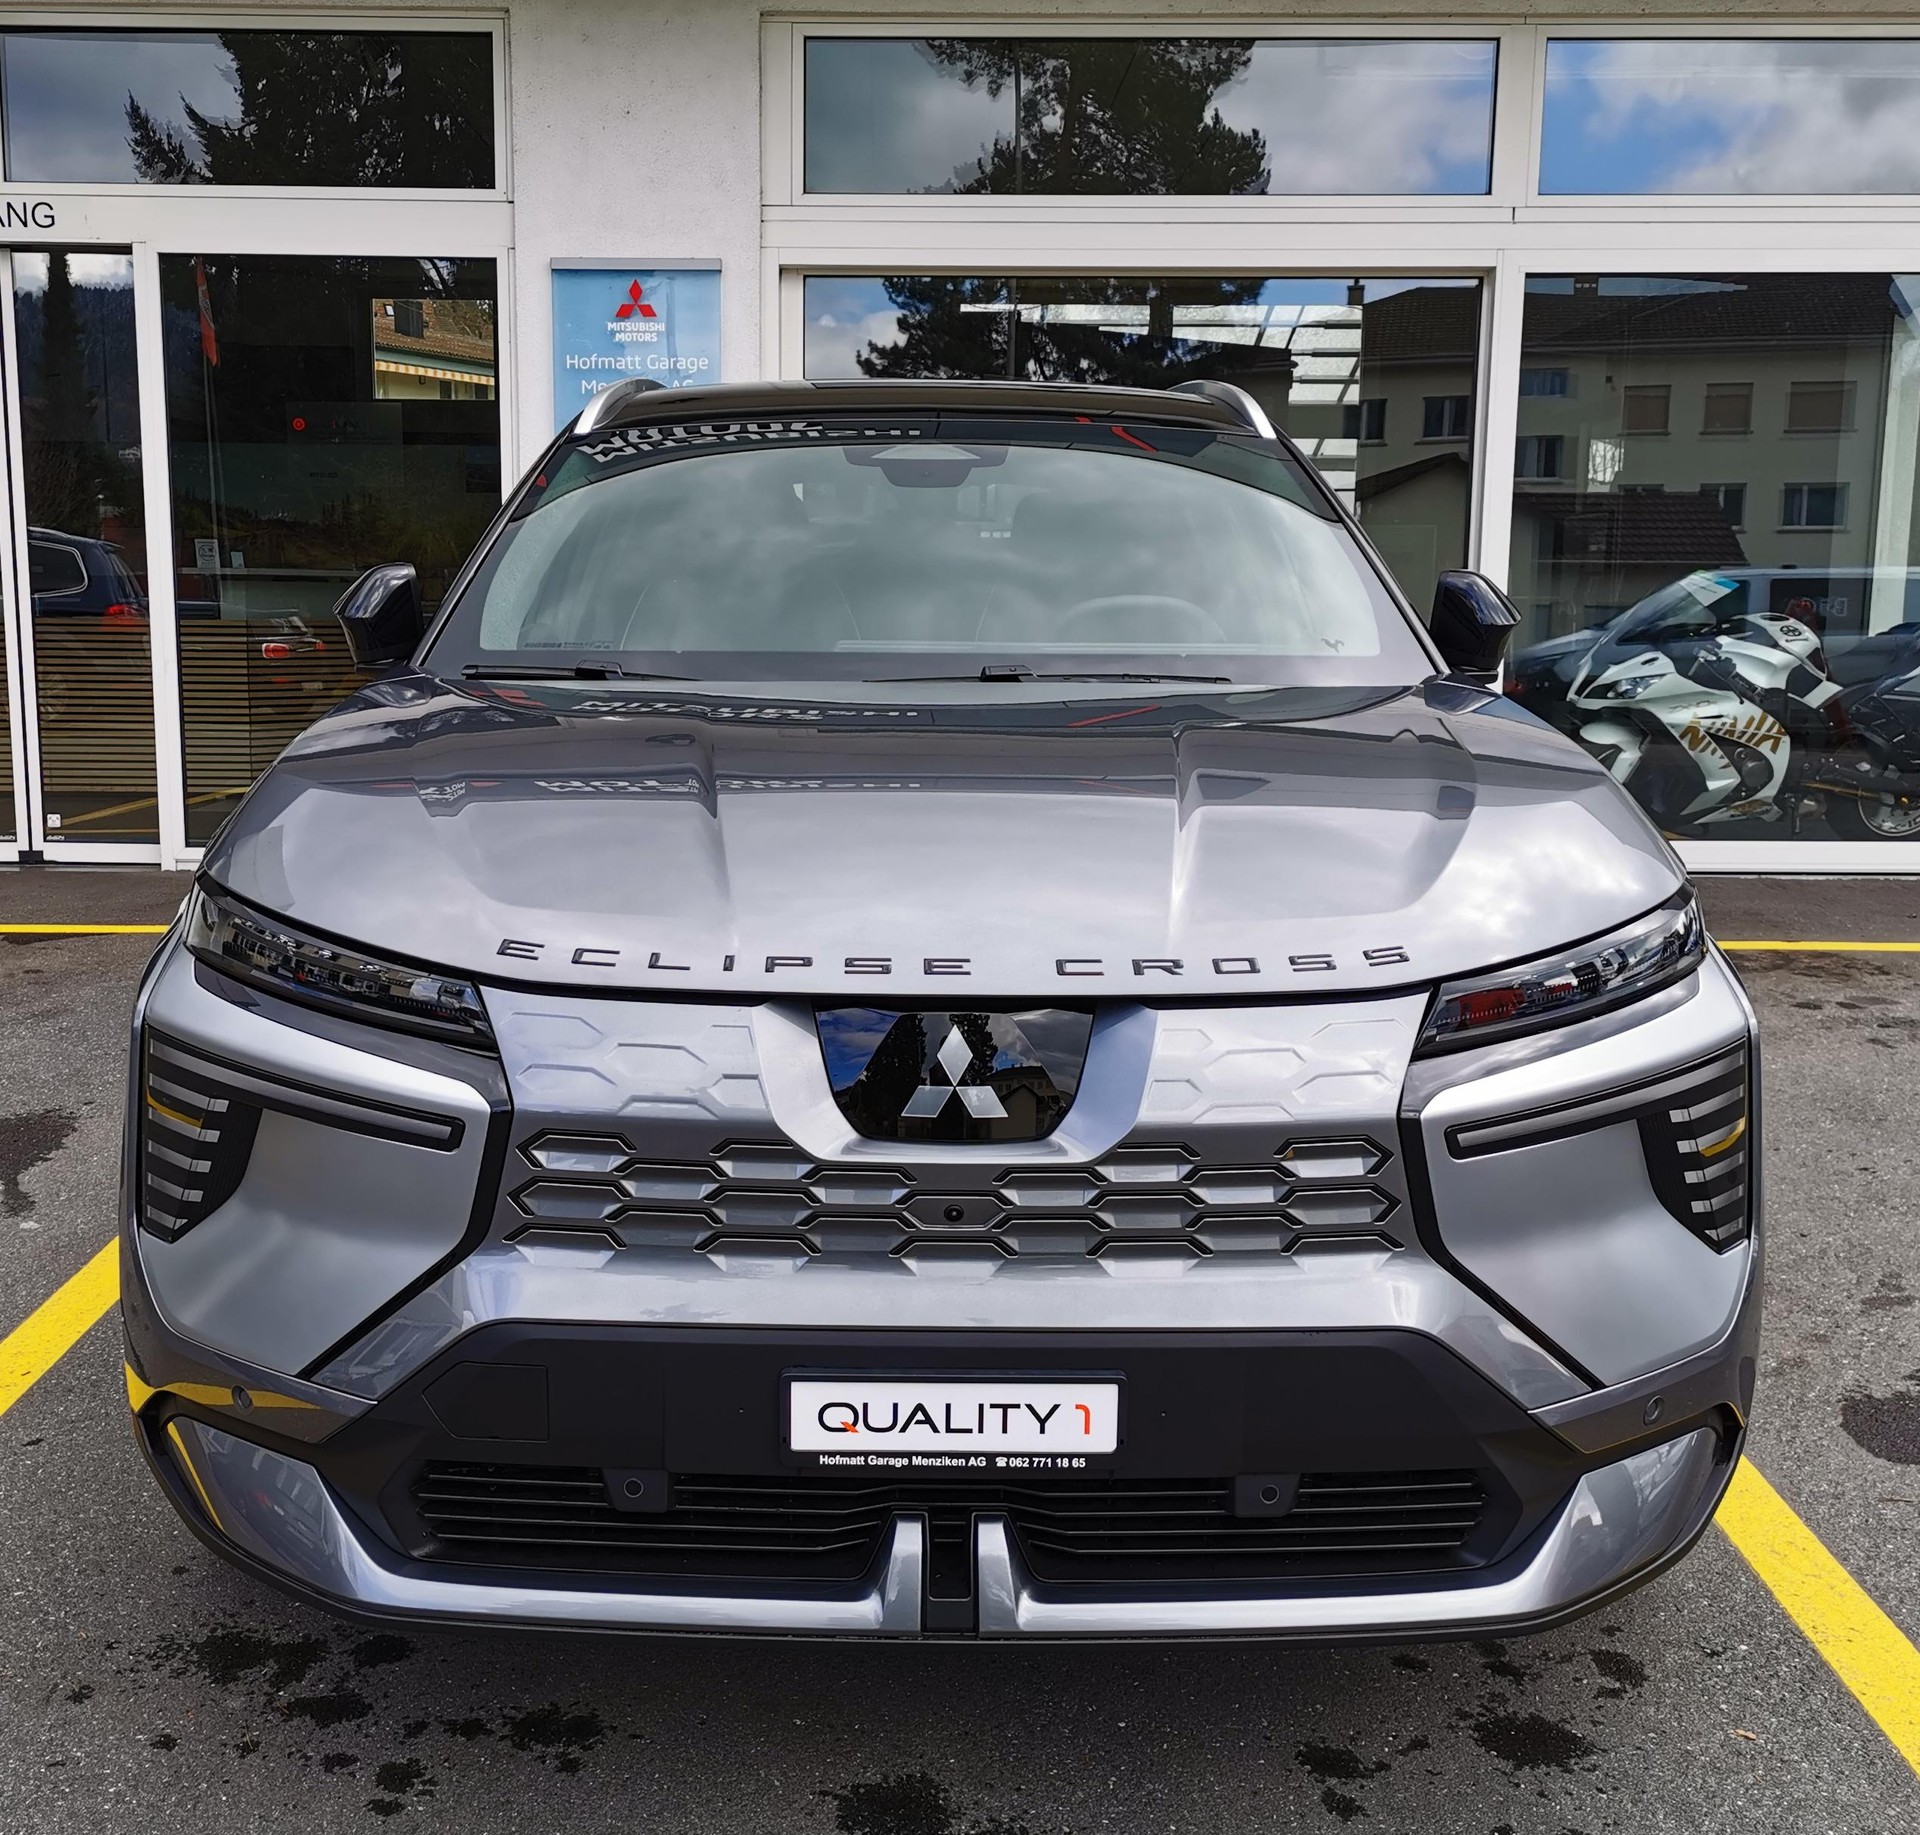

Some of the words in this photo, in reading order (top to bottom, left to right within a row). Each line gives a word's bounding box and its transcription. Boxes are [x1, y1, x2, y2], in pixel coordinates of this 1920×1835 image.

[0, 201, 55, 228] NG
[607, 322, 665, 331] MITSUBISHI
[615, 332, 658, 342] MOTORS
[566, 353, 641, 369] Hofmatt
[647, 354, 708, 373] Garage
[496, 938, 972, 975] ECLIPSE
[1055, 945, 1410, 976] CROSS
[817, 1402, 1061, 1434] QUALITY
[1075, 1404, 1091, 1434] 1
[819, 1455, 865, 1465] Hofmatt
[867, 1455, 909, 1468] Garage
[911, 1456, 966, 1466] Menziken
[967, 1456, 987, 1467] AG
[1008, 1457, 1029, 1468] 062
[1032, 1457, 1052, 1468] 771
[1056, 1457, 1069, 1468] 18
[1071, 1457, 1086, 1468] 65
